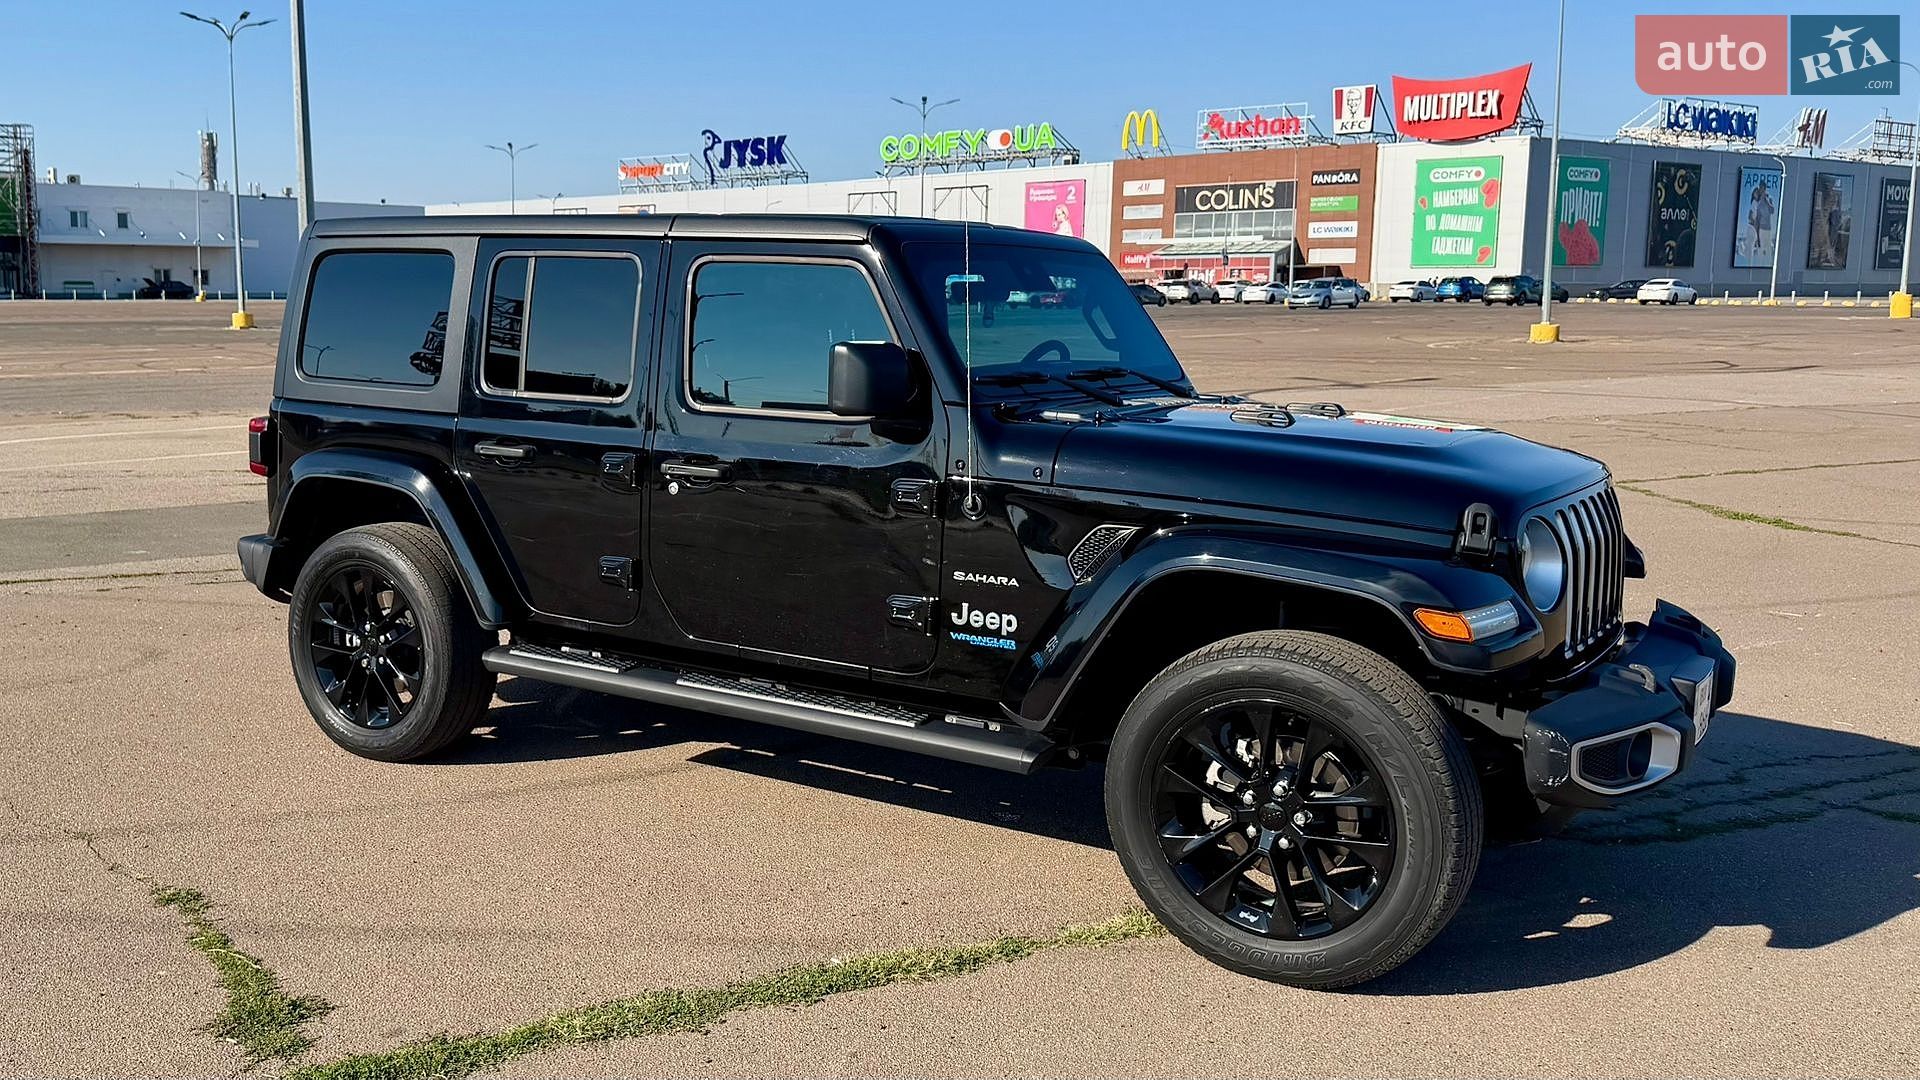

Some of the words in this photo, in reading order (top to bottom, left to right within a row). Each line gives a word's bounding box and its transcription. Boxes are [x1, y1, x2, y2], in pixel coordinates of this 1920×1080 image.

[1403, 89, 1502, 123] MULTIPLEX
[1203, 112, 1300, 140] Auchan
[1340, 119, 1367, 131] KFC
[719, 134, 788, 169] JYSK
[880, 127, 986, 162] COMFY
[1014, 121, 1057, 152] UA
[1312, 172, 1358, 184] PANDORA
[1432, 169, 1473, 180] COMFY
[1568, 168, 1594, 179] COMFY
[1195, 185, 1275, 211] COLIN'S
[1561, 187, 1602, 227] ПРИВІТ!
[953, 570, 1020, 588] SAHARA
[950, 602, 1018, 636] Jeep
[950, 631, 1016, 647] WRANGLER
